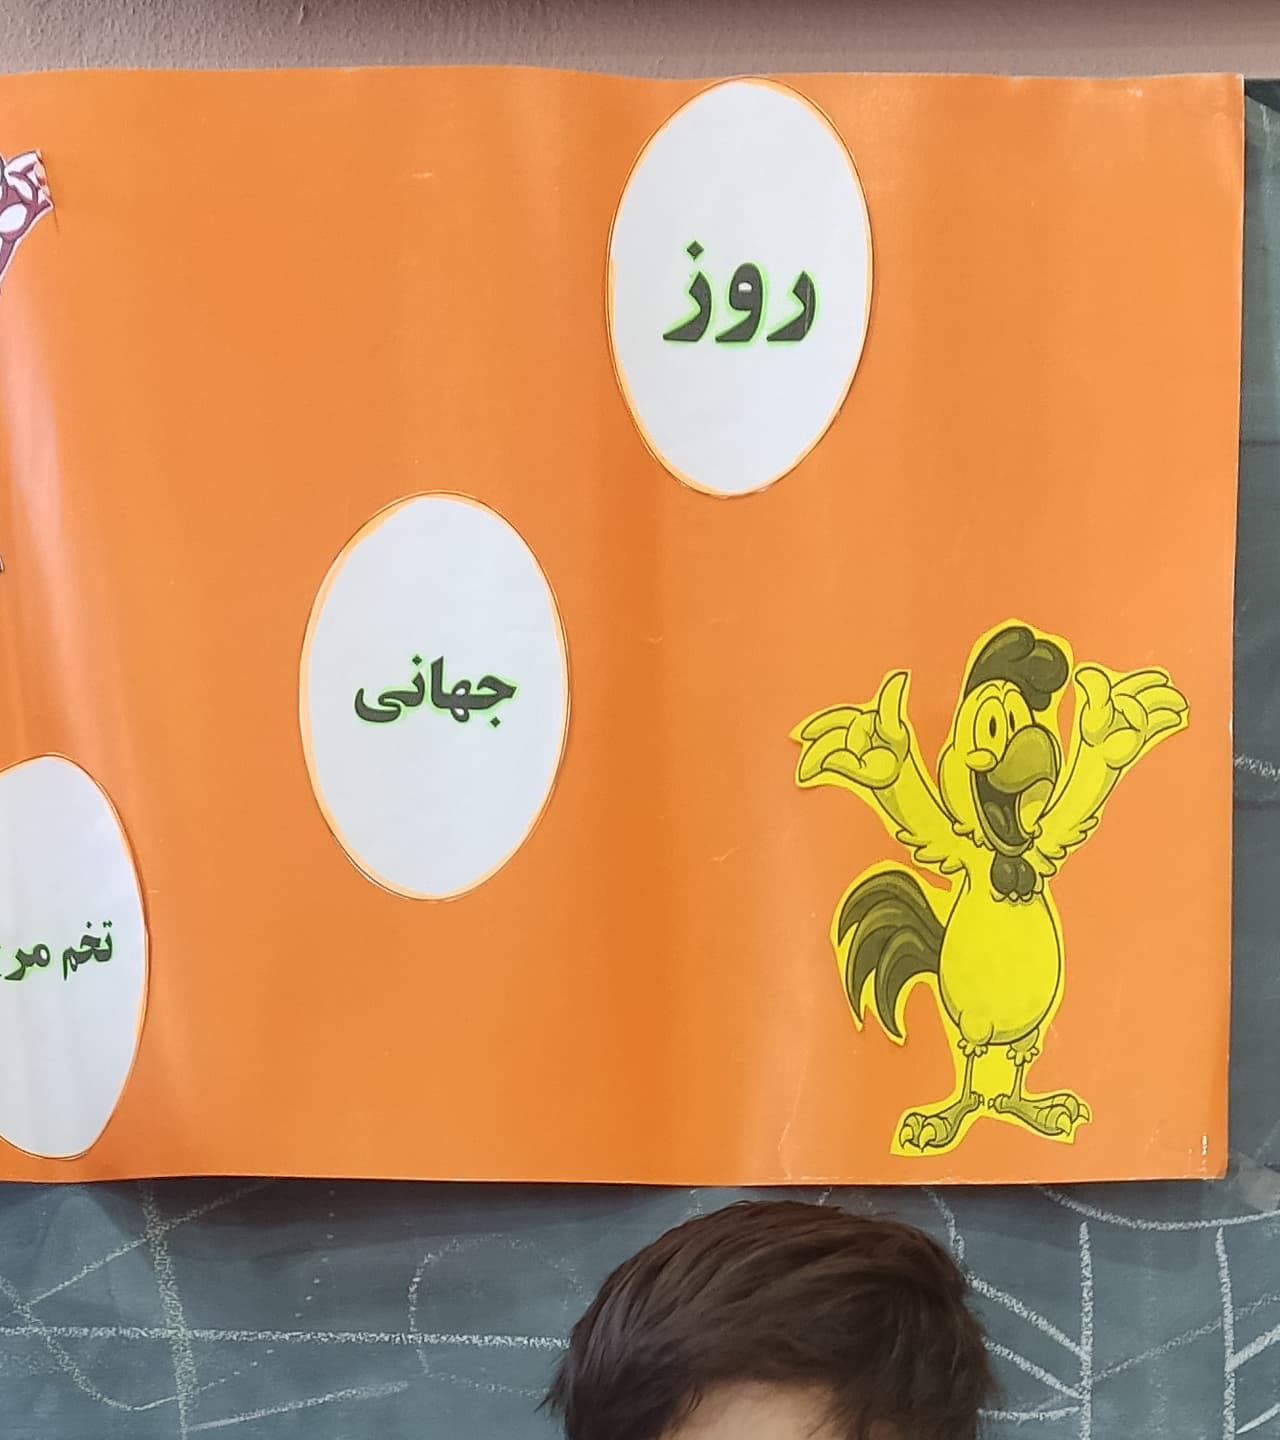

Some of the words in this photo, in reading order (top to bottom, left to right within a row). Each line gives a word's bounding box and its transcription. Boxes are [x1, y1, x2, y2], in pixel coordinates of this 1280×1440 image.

[662, 239, 816, 344] روز
[354, 654, 517, 729] جهانی
[62, 919, 113, 981] تخم
